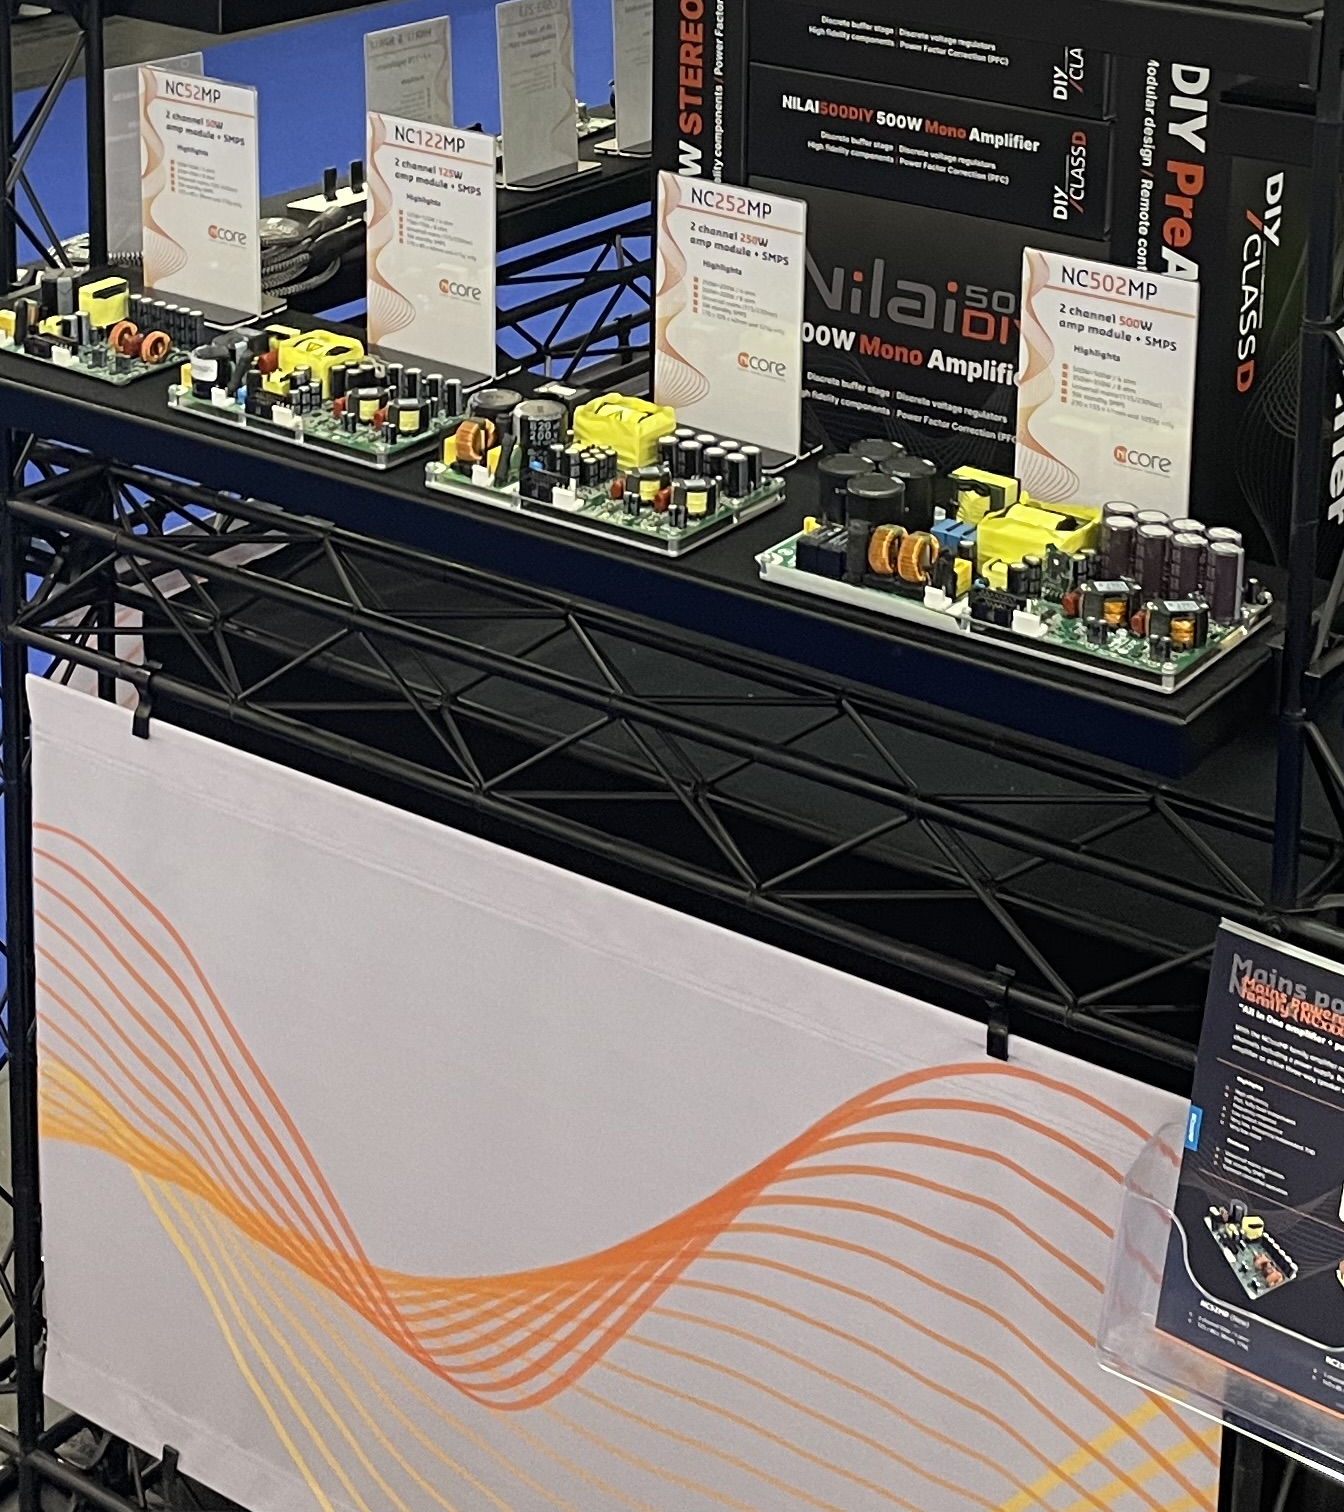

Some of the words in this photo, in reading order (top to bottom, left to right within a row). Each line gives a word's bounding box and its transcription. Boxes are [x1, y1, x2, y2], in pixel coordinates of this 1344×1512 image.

[714, 38, 724, 76] Power
[165, 79, 221, 104] NC52MP
[1053, 65, 1069, 100] DIY
[714, 85, 724, 158] components
[782, 94, 874, 123] NILAI500DIY
[876, 111, 923, 132] 500W
[924, 119, 967, 139] Mono
[968, 127, 1040, 153] Amplifier
[1168, 63, 1211, 154] DIY
[223, 133, 245, 146] SMPS
[394, 125, 466, 154] NC122MP
[1140, 116, 1156, 167] design
[401, 158, 437, 175] channel
[679, 139, 702, 176] W
[1069, 131, 1087, 201] CLASSD
[394, 170, 414, 183] amp
[415, 175, 448, 190] module
[457, 182, 482, 196] SMPS
[690, 186, 773, 220] NC252MP
[1053, 184, 1069, 220] DIY
[1138, 178, 1154, 236] Remote
[1263, 171, 1284, 246] DIY
[698, 223, 739, 241] channel
[689, 236, 712, 249] amp
[714, 240, 752, 258] module
[762, 251, 790, 267] SMPS
[806, 246, 957, 334] Nilai
[1061, 265, 1158, 301] NC502MP
[1069, 306, 1116, 324] channel
[1118, 314, 1154, 332] 500W
[1236, 233, 1262, 394] CLASSD
[859, 334, 923, 366] Mono
[1059, 319, 1085, 334] amp
[1087, 324, 1132, 342] module
[1144, 335, 1178, 352] SMPS
[1073, 345, 1121, 363] Highlights
[840, 397, 891, 416] components
[896, 409, 922, 423] Power
[924, 415, 950, 429] Factor
[951, 421, 996, 439] Correction
[896, 391, 931, 407] Discrete
[932, 398, 963, 414] voltage
[964, 405, 1008, 423] regulators
[1232, 953, 1307, 999] Mains
[1266, 1014, 1284, 1028] One
[1284, 1023, 1326, 1045] amplifier
